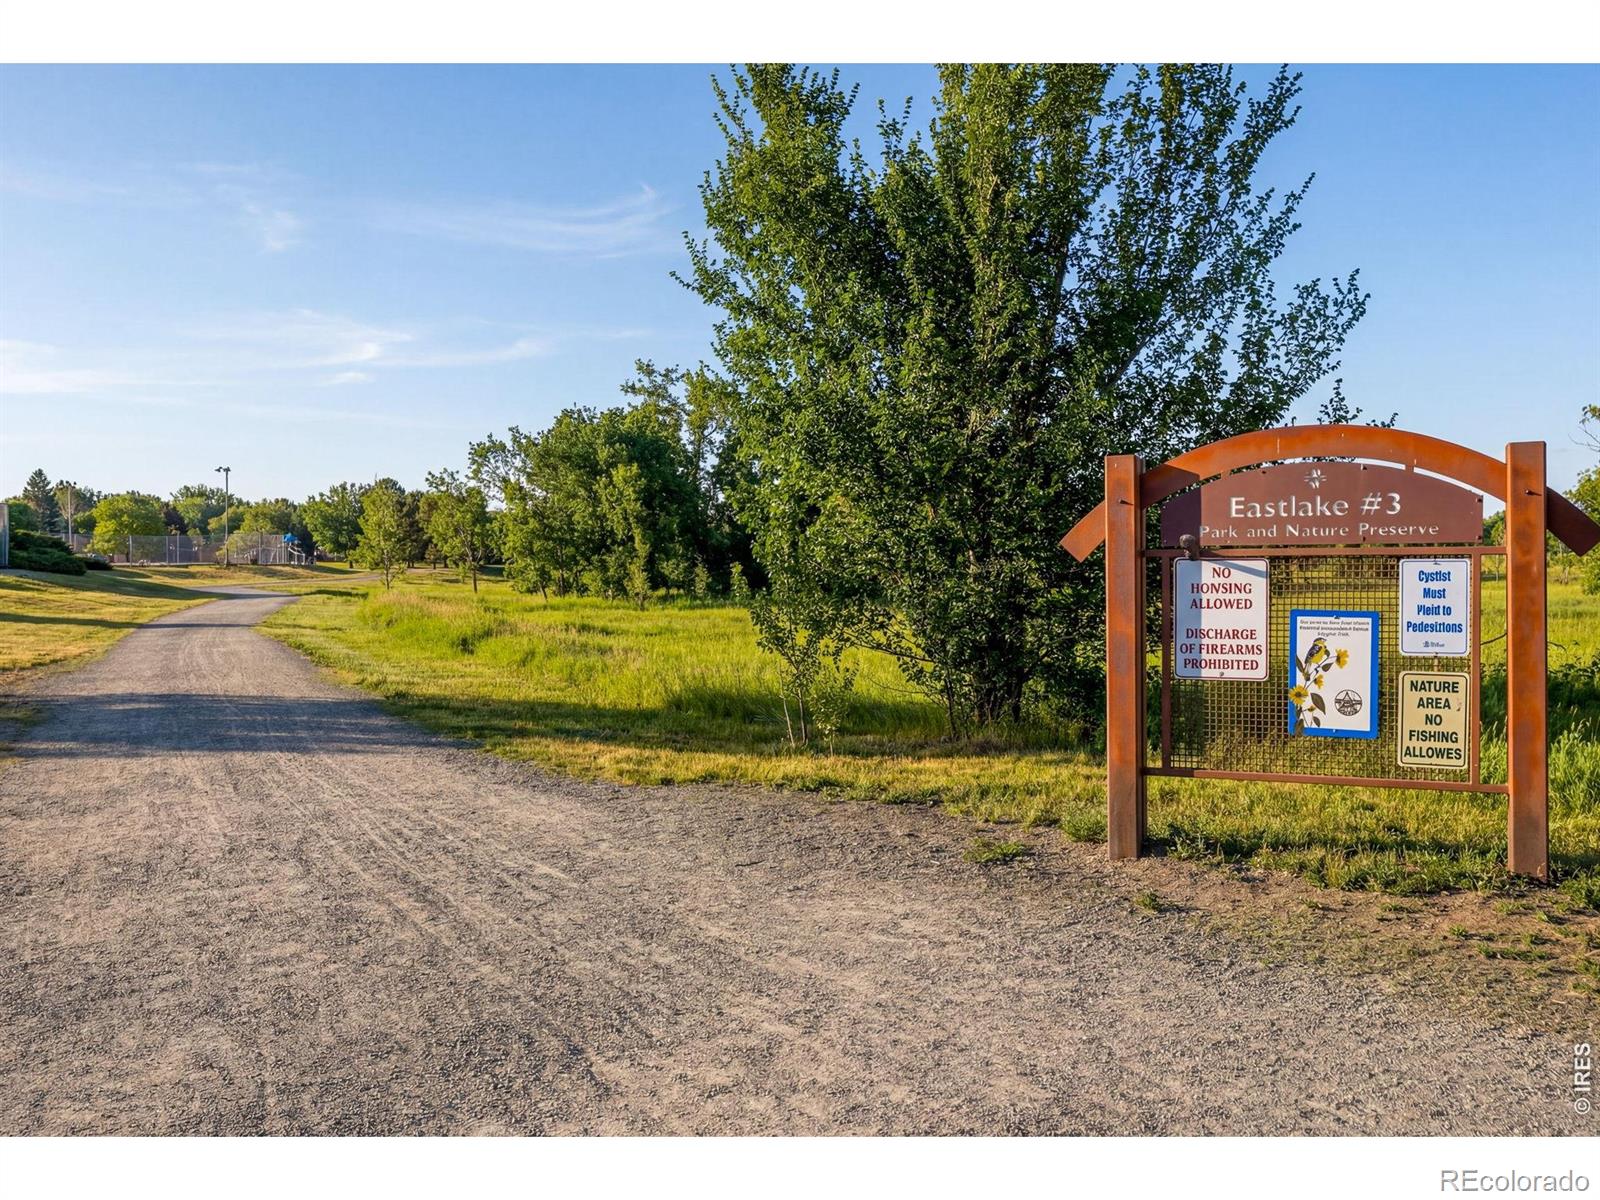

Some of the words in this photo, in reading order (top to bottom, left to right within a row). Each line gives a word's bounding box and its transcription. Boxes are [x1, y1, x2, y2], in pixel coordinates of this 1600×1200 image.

[1230, 495, 1349, 518] Eastlake
[1360, 492, 1402, 516] #3
[1199, 525, 1238, 538] Park
[1247, 525, 1277, 538] and
[1286, 524, 1349, 537] Nature
[1359, 522, 1440, 537] Preserve
[1212, 567, 1231, 578] NO
[1423, 588, 1446, 599] Must
[1190, 598, 1253, 609] ALLOWED
[1442, 605, 1452, 616] to
[1186, 628, 1257, 640] DISCHARGE
[1180, 643, 1196, 654] OF
[1199, 644, 1263, 655] FIREARMS
[1184, 659, 1259, 670] PROHIBITED
[1410, 680, 1459, 693] NATURE
[1417, 697, 1451, 709] AREA
[1425, 714, 1443, 726] NO
[1409, 730, 1459, 743] FISHING
[1404, 746, 1462, 760] ALLOWES
